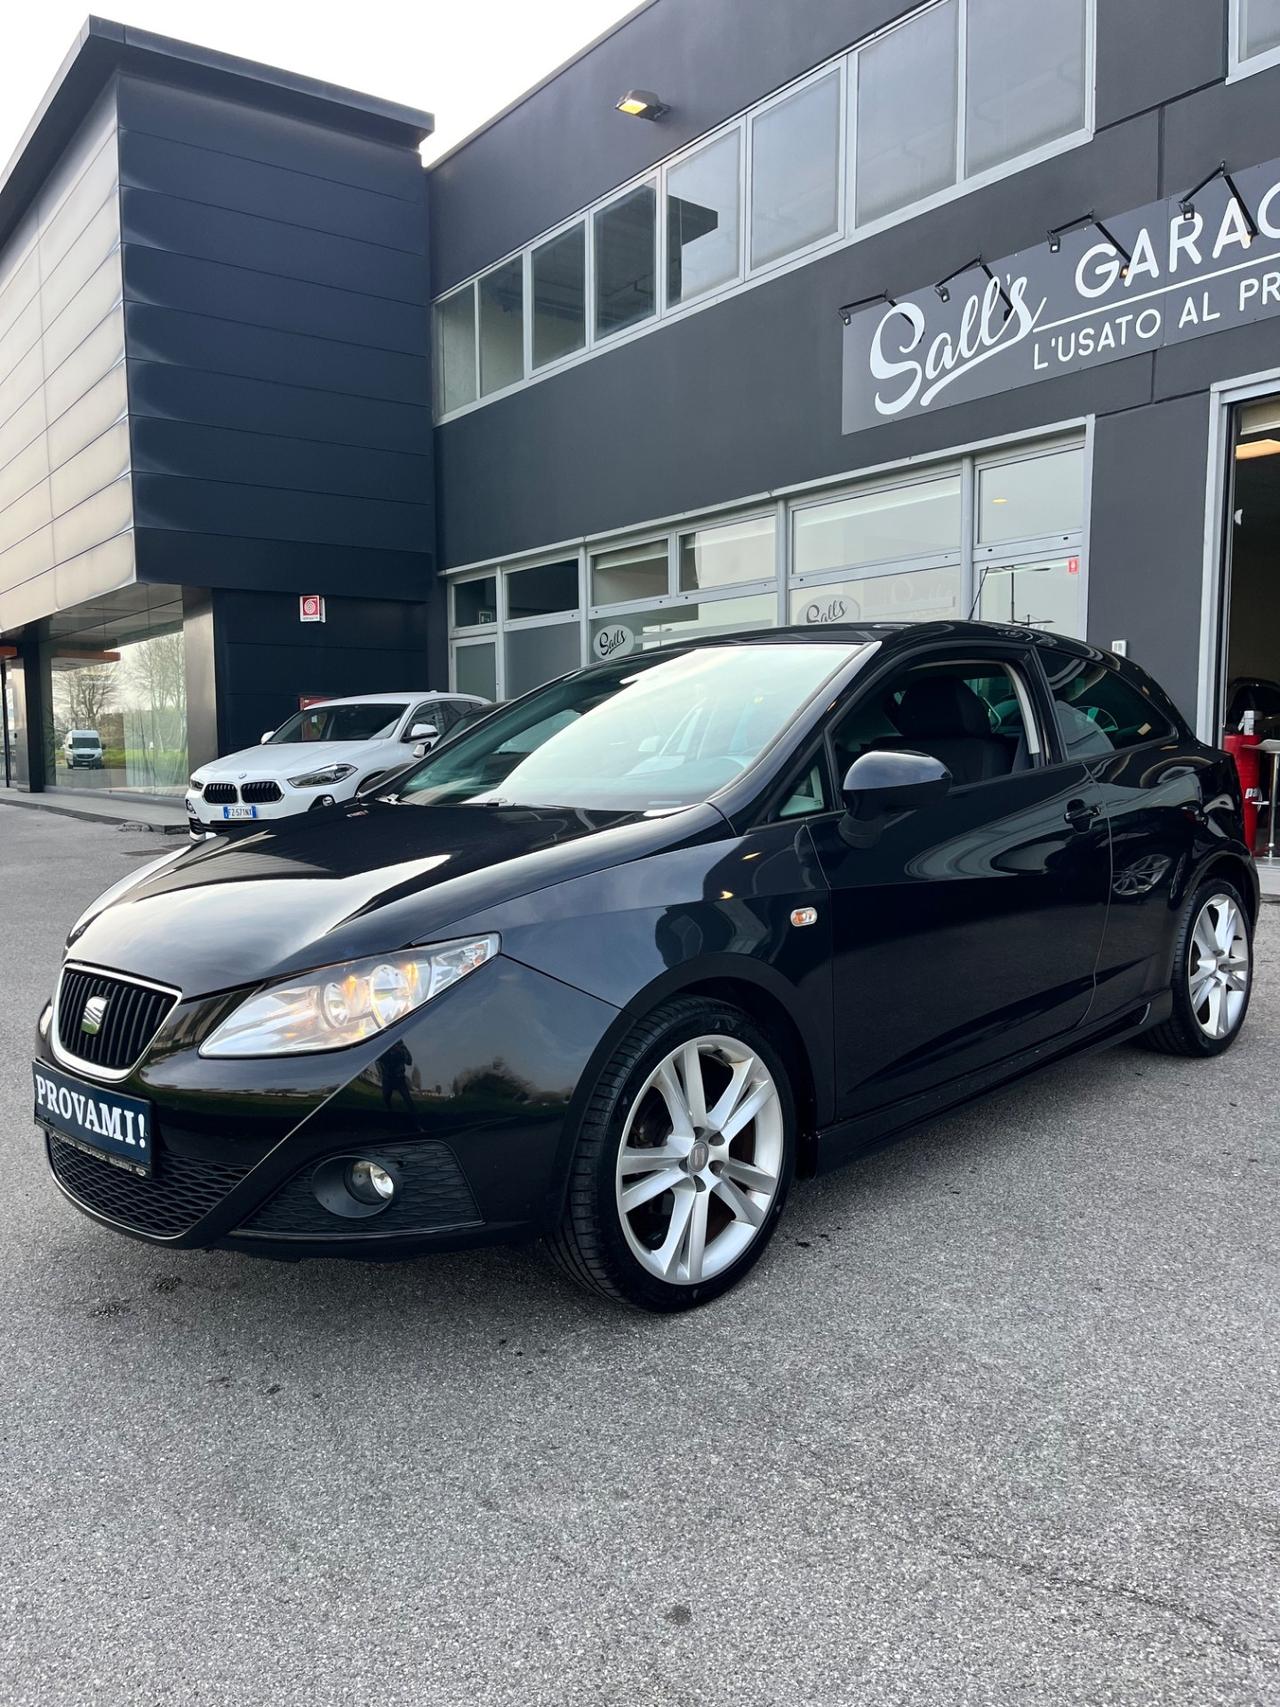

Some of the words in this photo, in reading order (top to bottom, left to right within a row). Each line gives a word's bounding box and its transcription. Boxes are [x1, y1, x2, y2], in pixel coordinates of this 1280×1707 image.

[869, 273, 1047, 415] Sall's
[1033, 308, 1162, 370] L'USATO
[1178, 291, 1221, 329] AL
[35, 1073, 146, 1149] PROVAMI!
